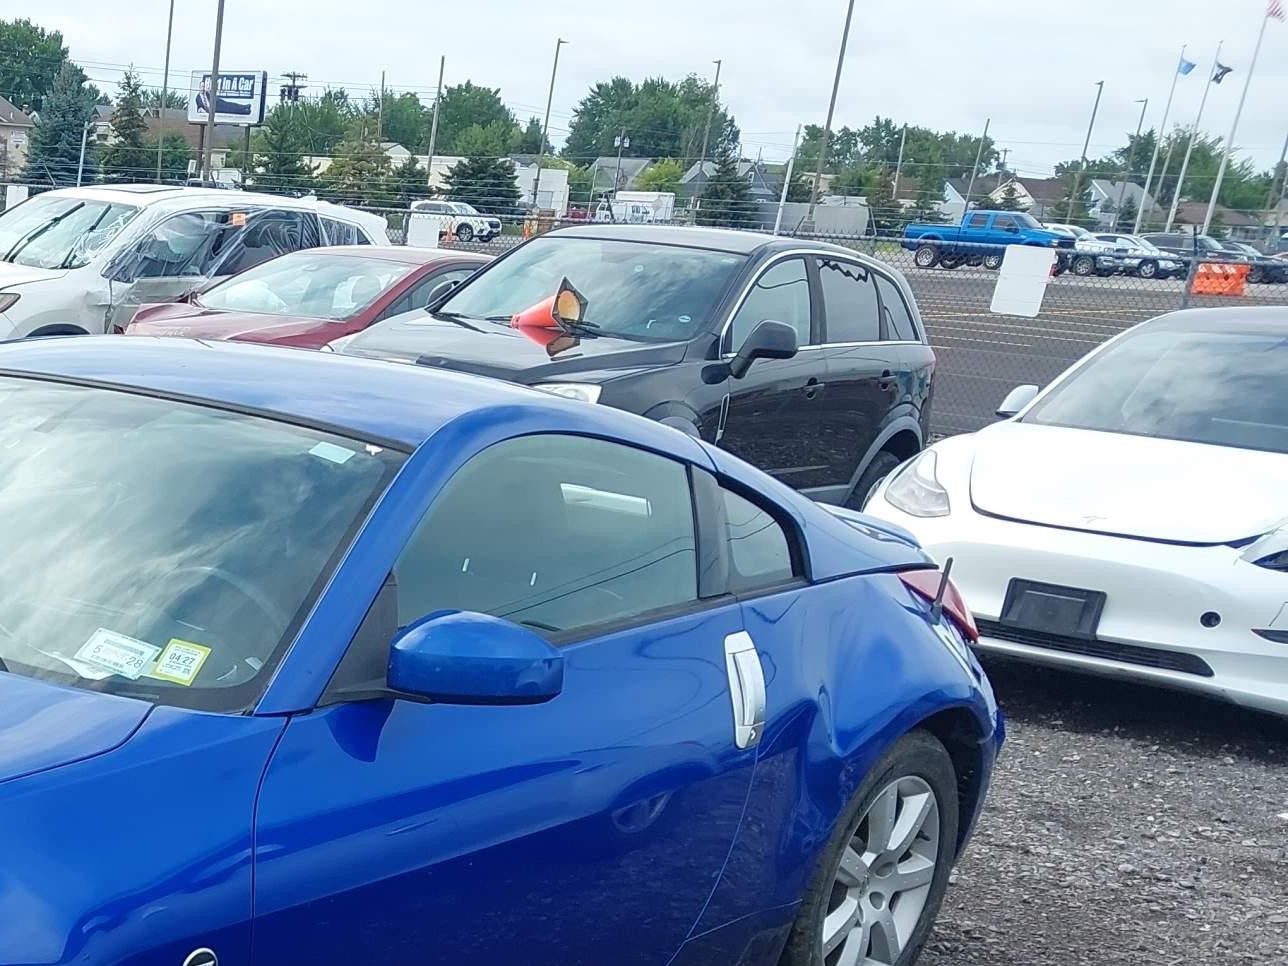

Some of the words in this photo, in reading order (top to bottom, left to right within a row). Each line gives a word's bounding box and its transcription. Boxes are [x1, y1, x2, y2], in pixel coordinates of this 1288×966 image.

[232, 77, 238, 90] A
[239, 77, 254, 90] Car
[126, 656, 144, 668] 28
